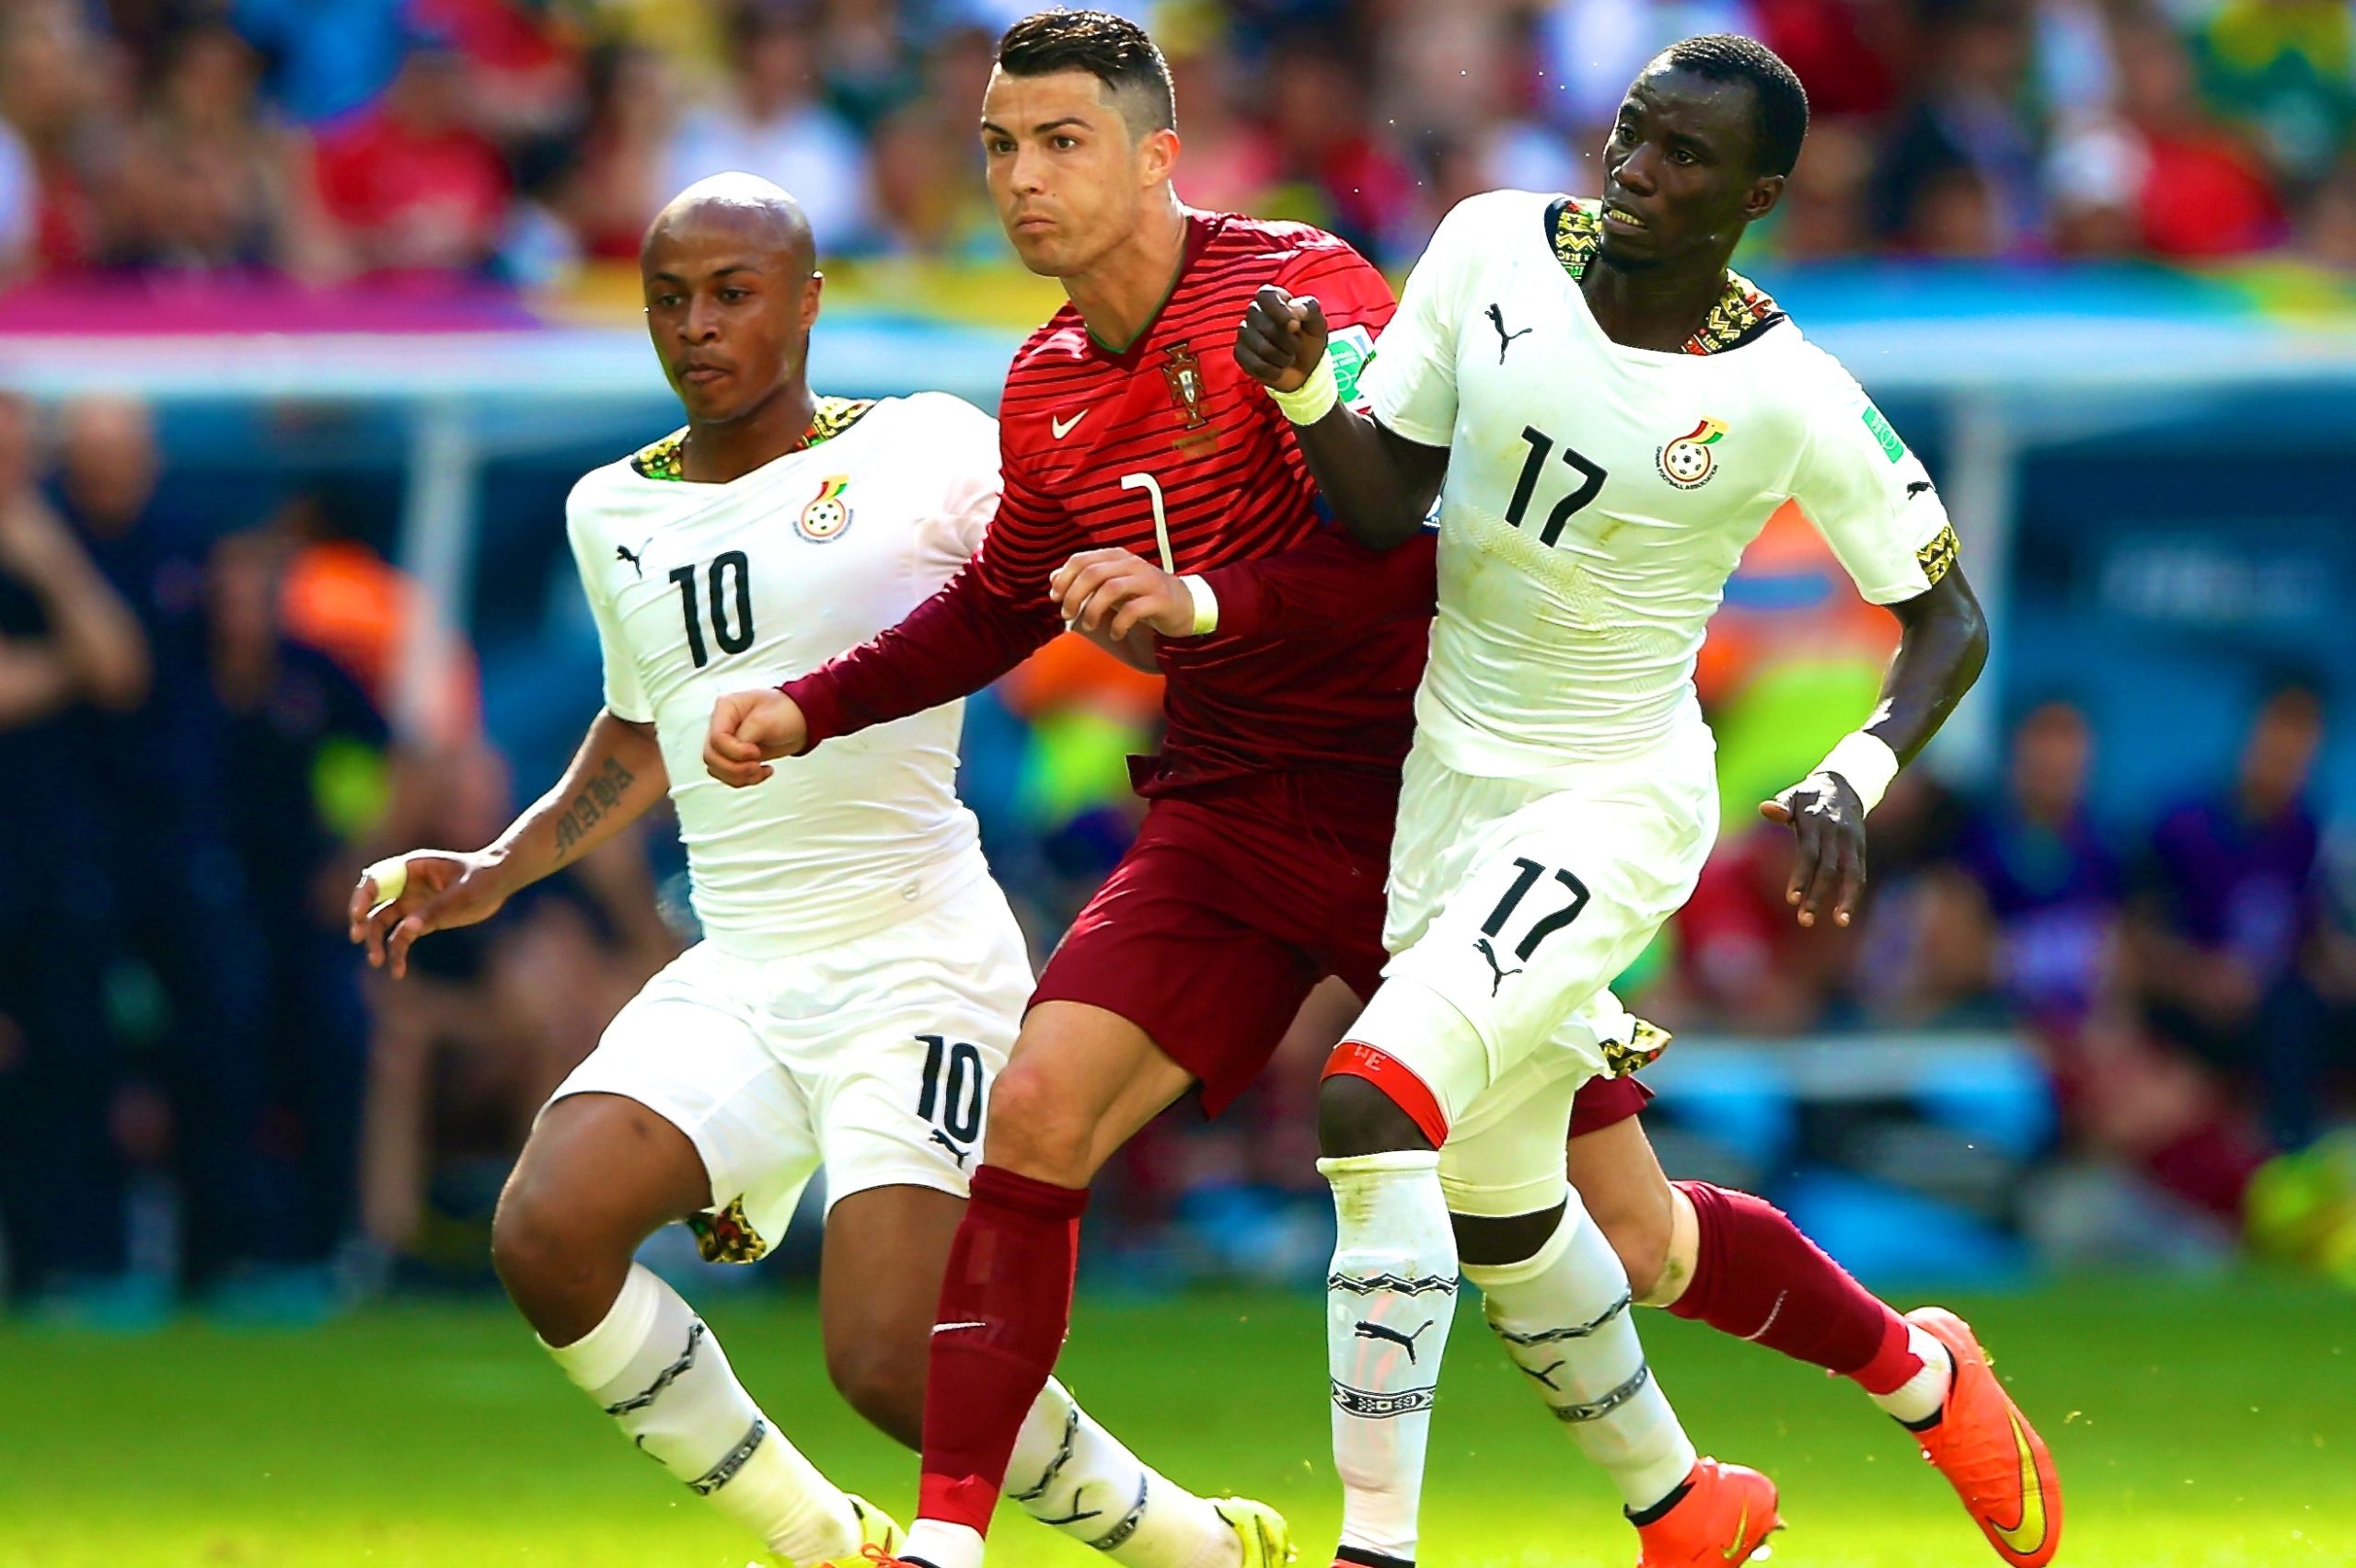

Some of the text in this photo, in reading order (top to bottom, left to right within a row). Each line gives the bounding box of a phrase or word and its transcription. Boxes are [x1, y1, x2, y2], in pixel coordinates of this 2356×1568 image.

[1120, 472, 1174, 574] 7
[1505, 425, 1609, 548] 17
[669, 550, 755, 669] 10
[1480, 856, 1591, 963] 17
[914, 1034, 984, 1144] 10
